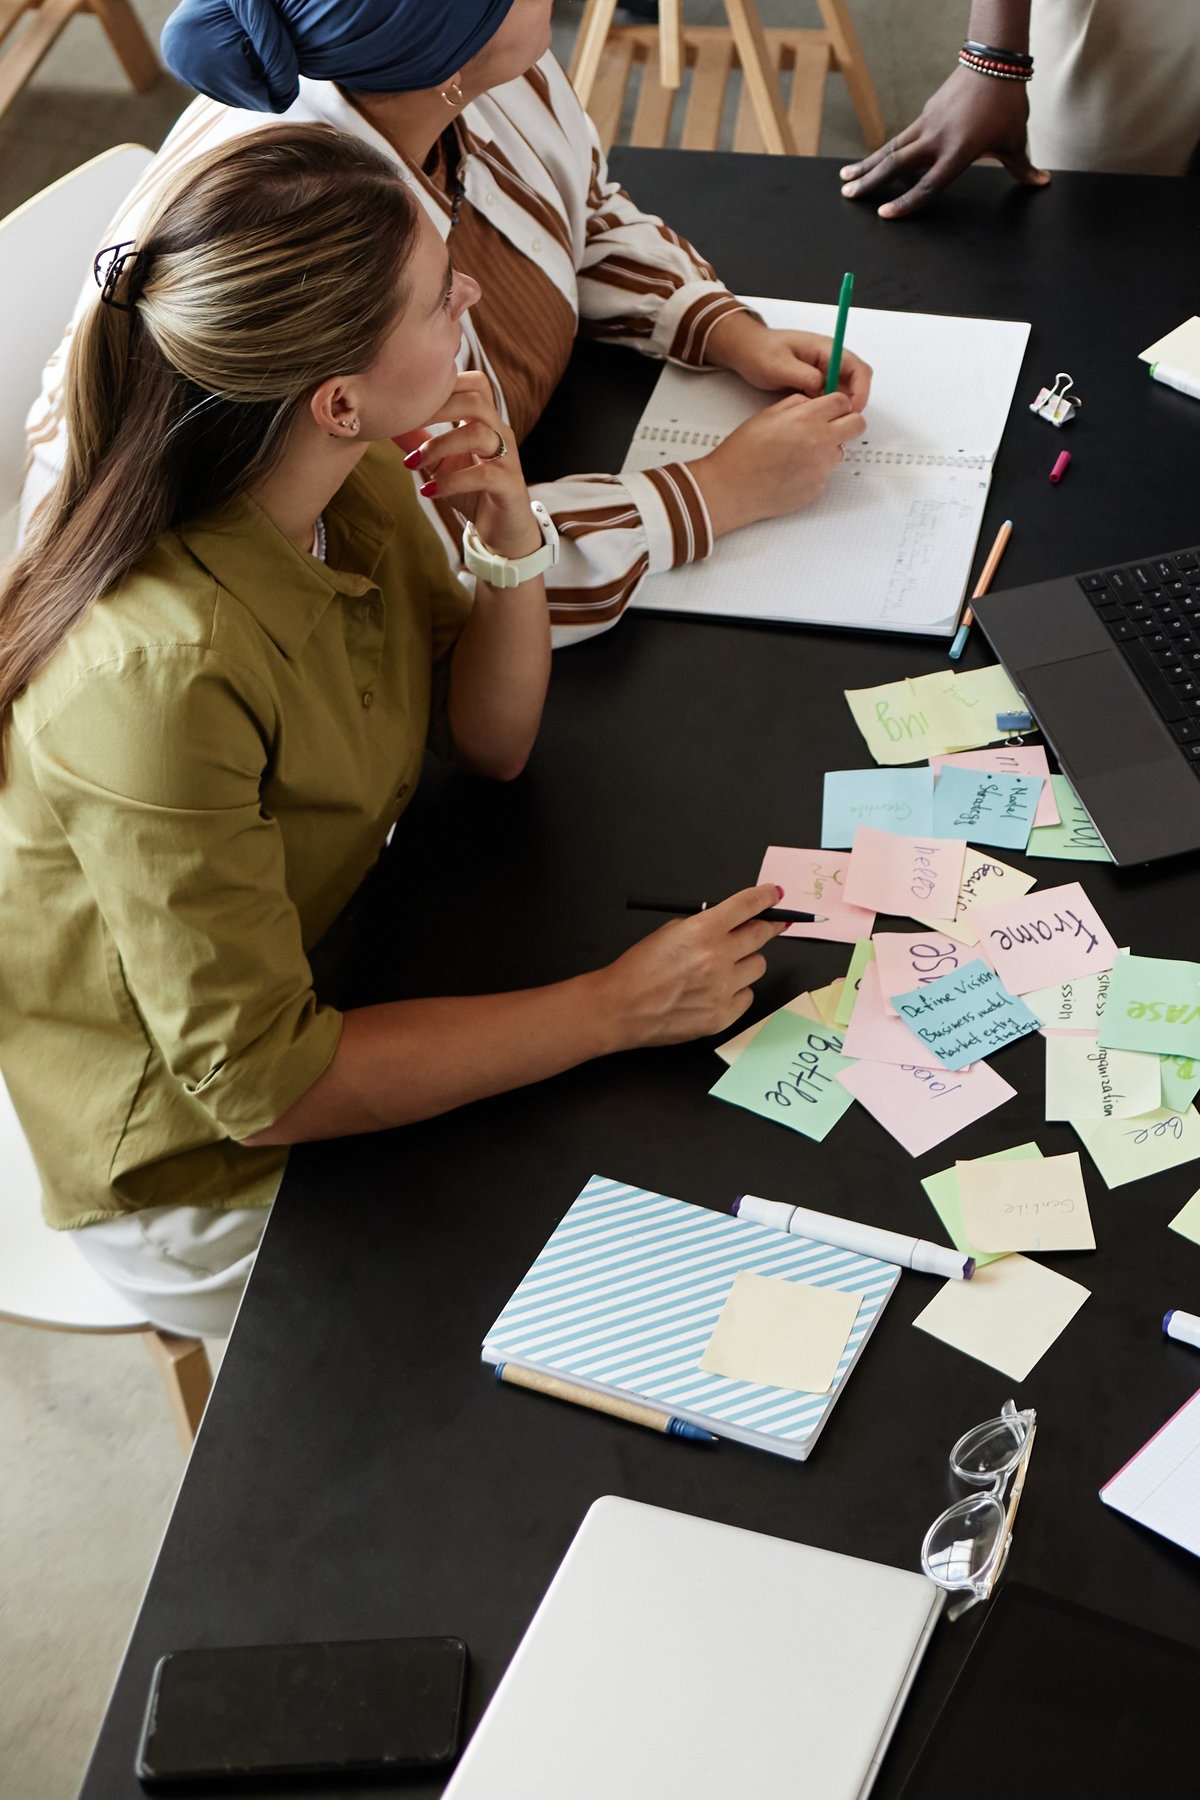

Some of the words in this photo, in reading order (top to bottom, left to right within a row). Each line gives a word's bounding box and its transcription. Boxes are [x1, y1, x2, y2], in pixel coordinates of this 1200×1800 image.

[911, 845, 941, 900] hello
[991, 909, 1098, 954] Frame
[1087, 1046, 1127, 1118] rganization
